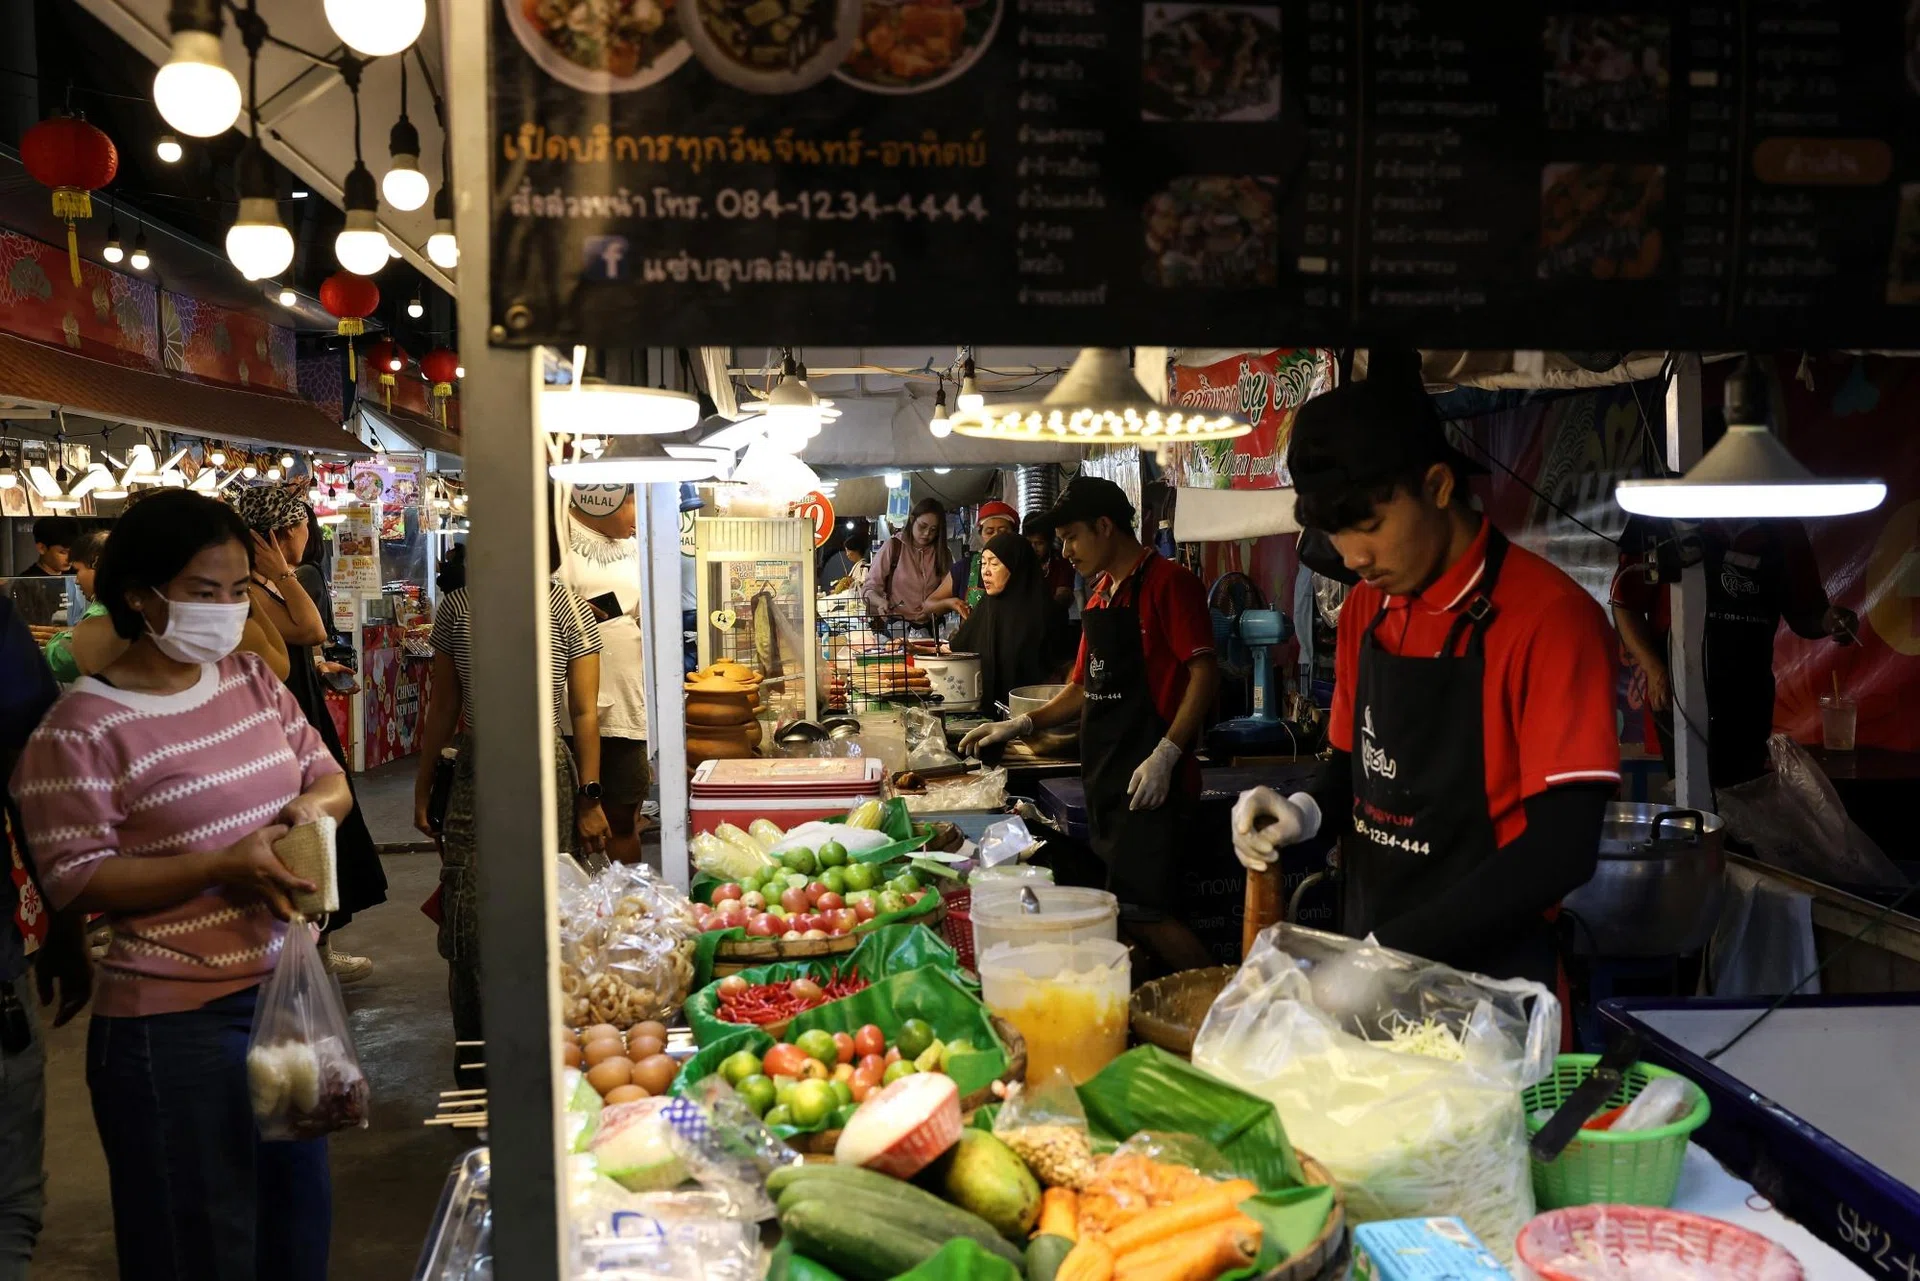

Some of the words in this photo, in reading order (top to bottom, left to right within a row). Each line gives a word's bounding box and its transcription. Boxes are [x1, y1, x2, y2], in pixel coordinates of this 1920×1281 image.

[715, 189, 988, 221] 084-1234-4444
[580, 493, 615, 507] HALAL
[680, 536, 696, 546] HAL
[396, 703, 407, 716] NEW
[1184, 870, 1241, 897] Snow
